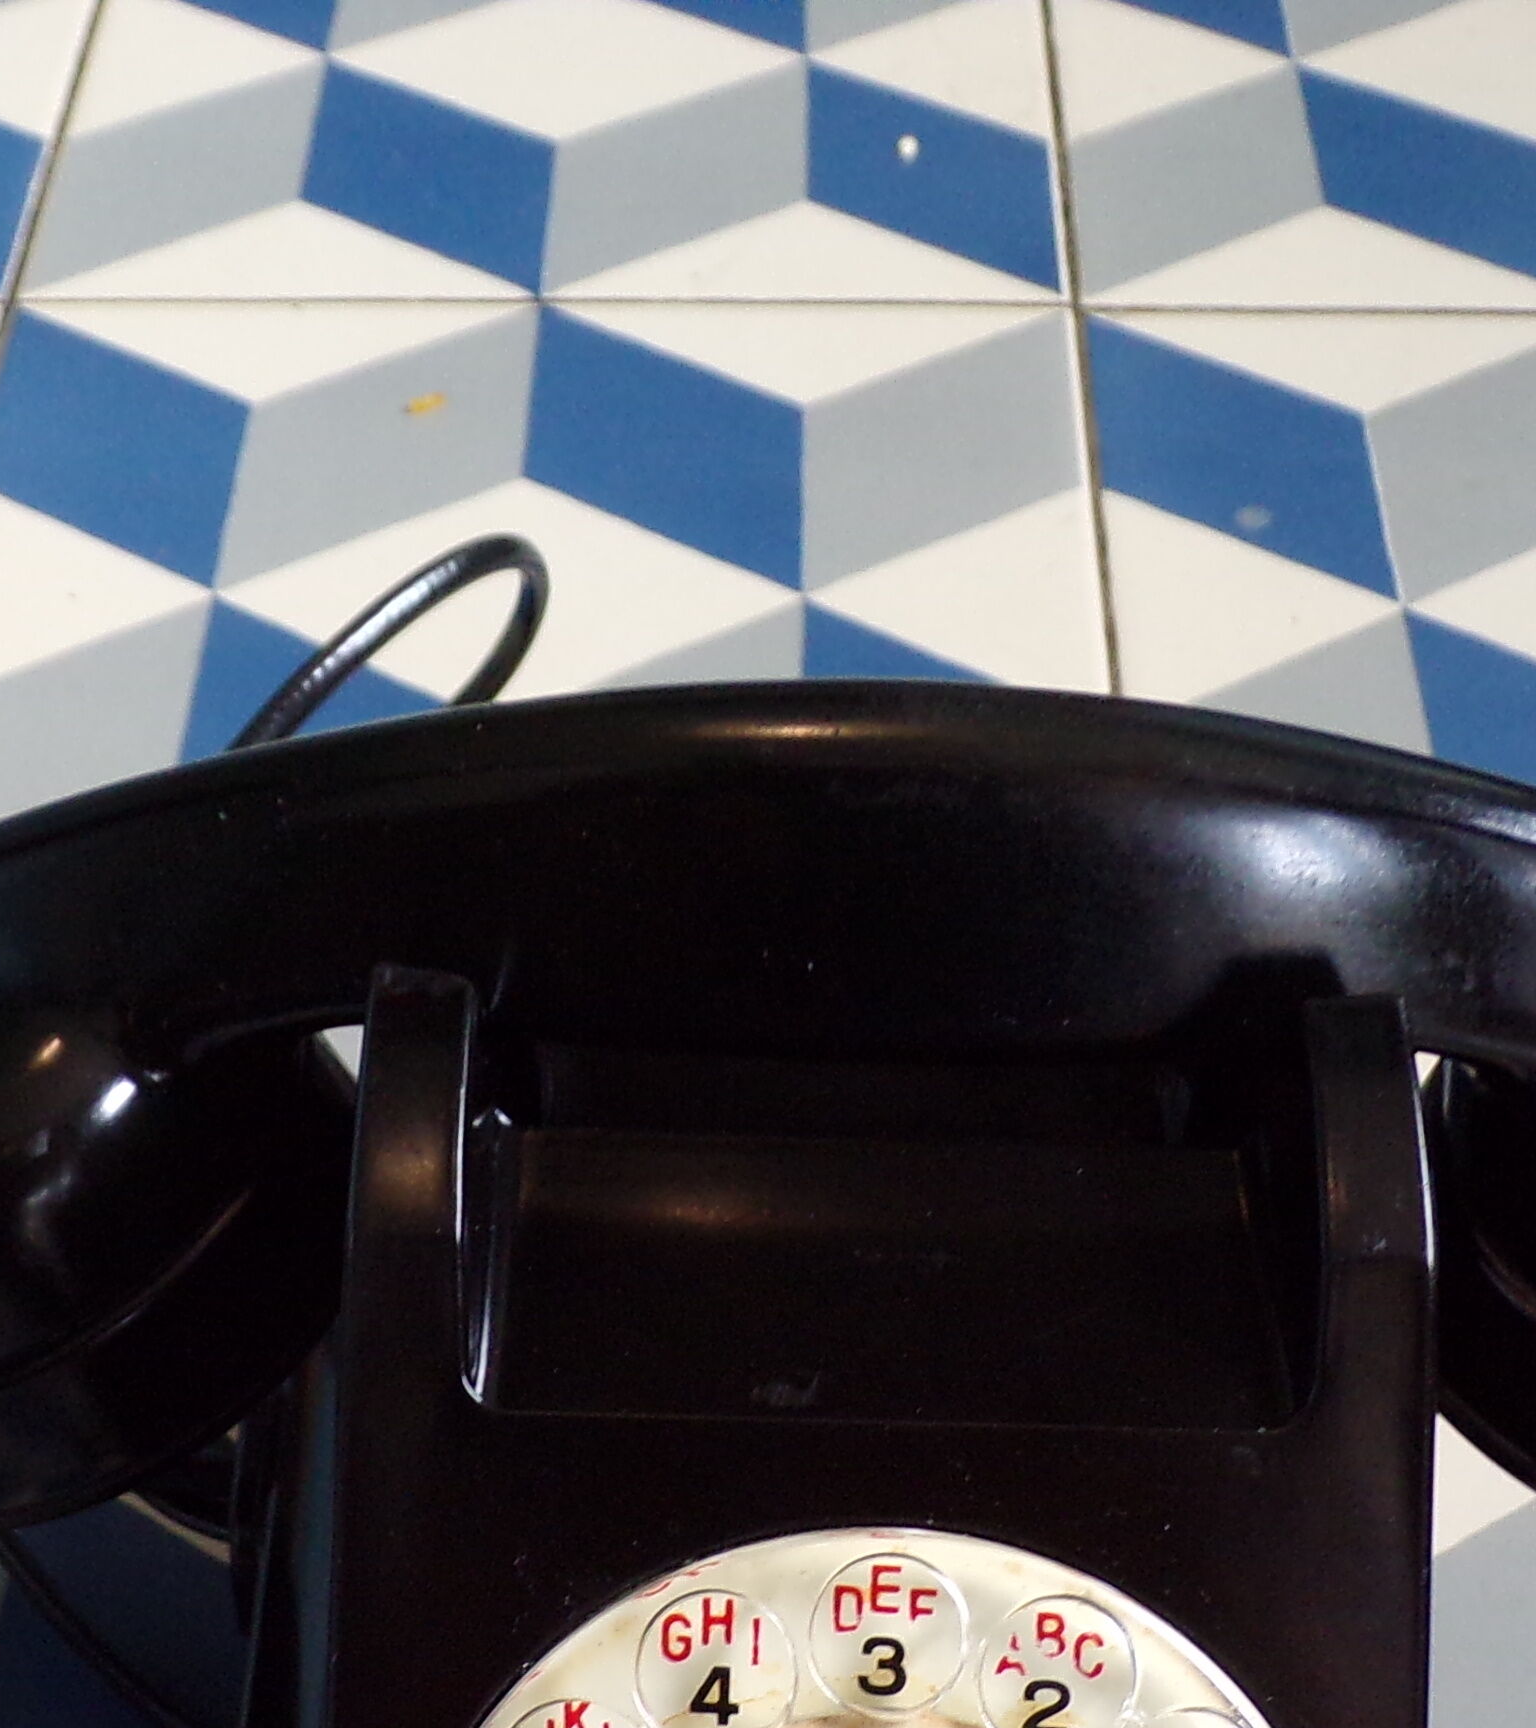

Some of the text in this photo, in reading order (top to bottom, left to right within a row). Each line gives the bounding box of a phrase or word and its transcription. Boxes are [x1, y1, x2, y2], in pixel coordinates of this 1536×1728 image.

[661, 1597, 761, 1665] GHI
[833, 1565, 938, 1633] DEF
[858, 1637, 907, 1696] 3
[995, 1612, 1105, 1678] ABC
[689, 1666, 739, 1726] 4
